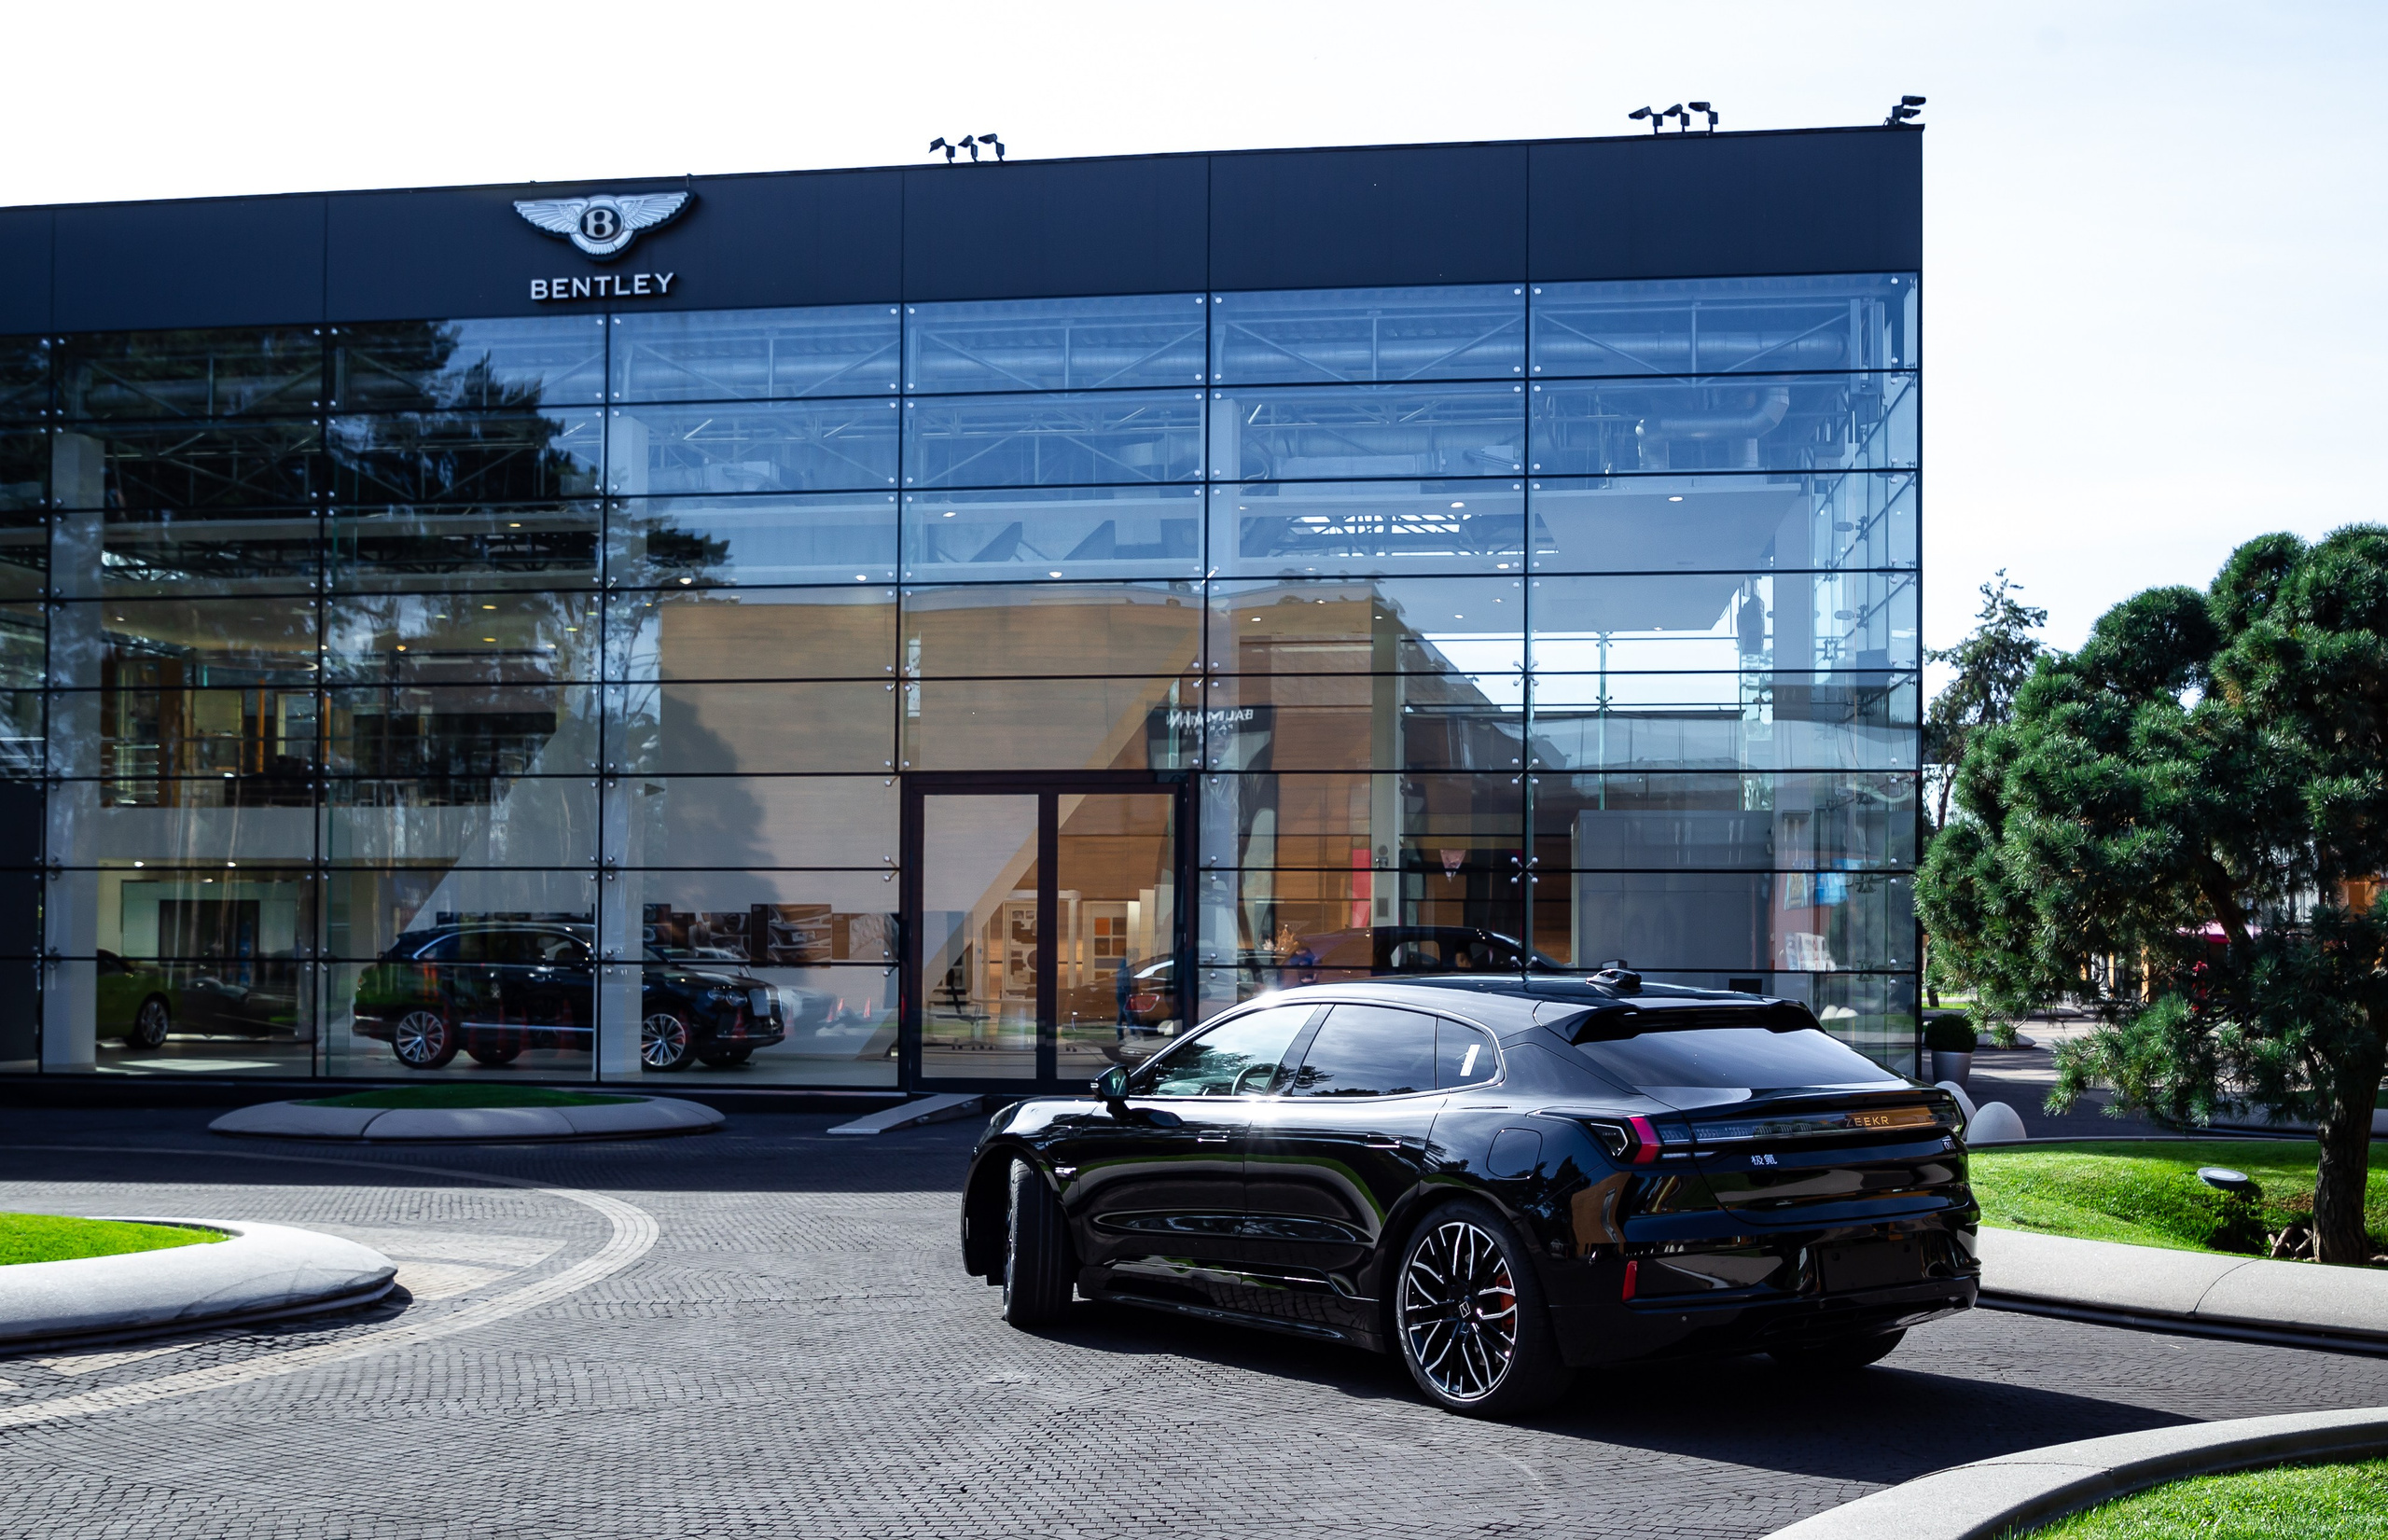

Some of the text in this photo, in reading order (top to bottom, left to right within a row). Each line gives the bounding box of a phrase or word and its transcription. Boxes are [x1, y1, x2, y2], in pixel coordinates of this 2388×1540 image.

[531, 272, 673, 299] BENTLEY
[1844, 1116, 1890, 1128] ZEEKR
[1750, 1154, 1778, 1166] 极氪
